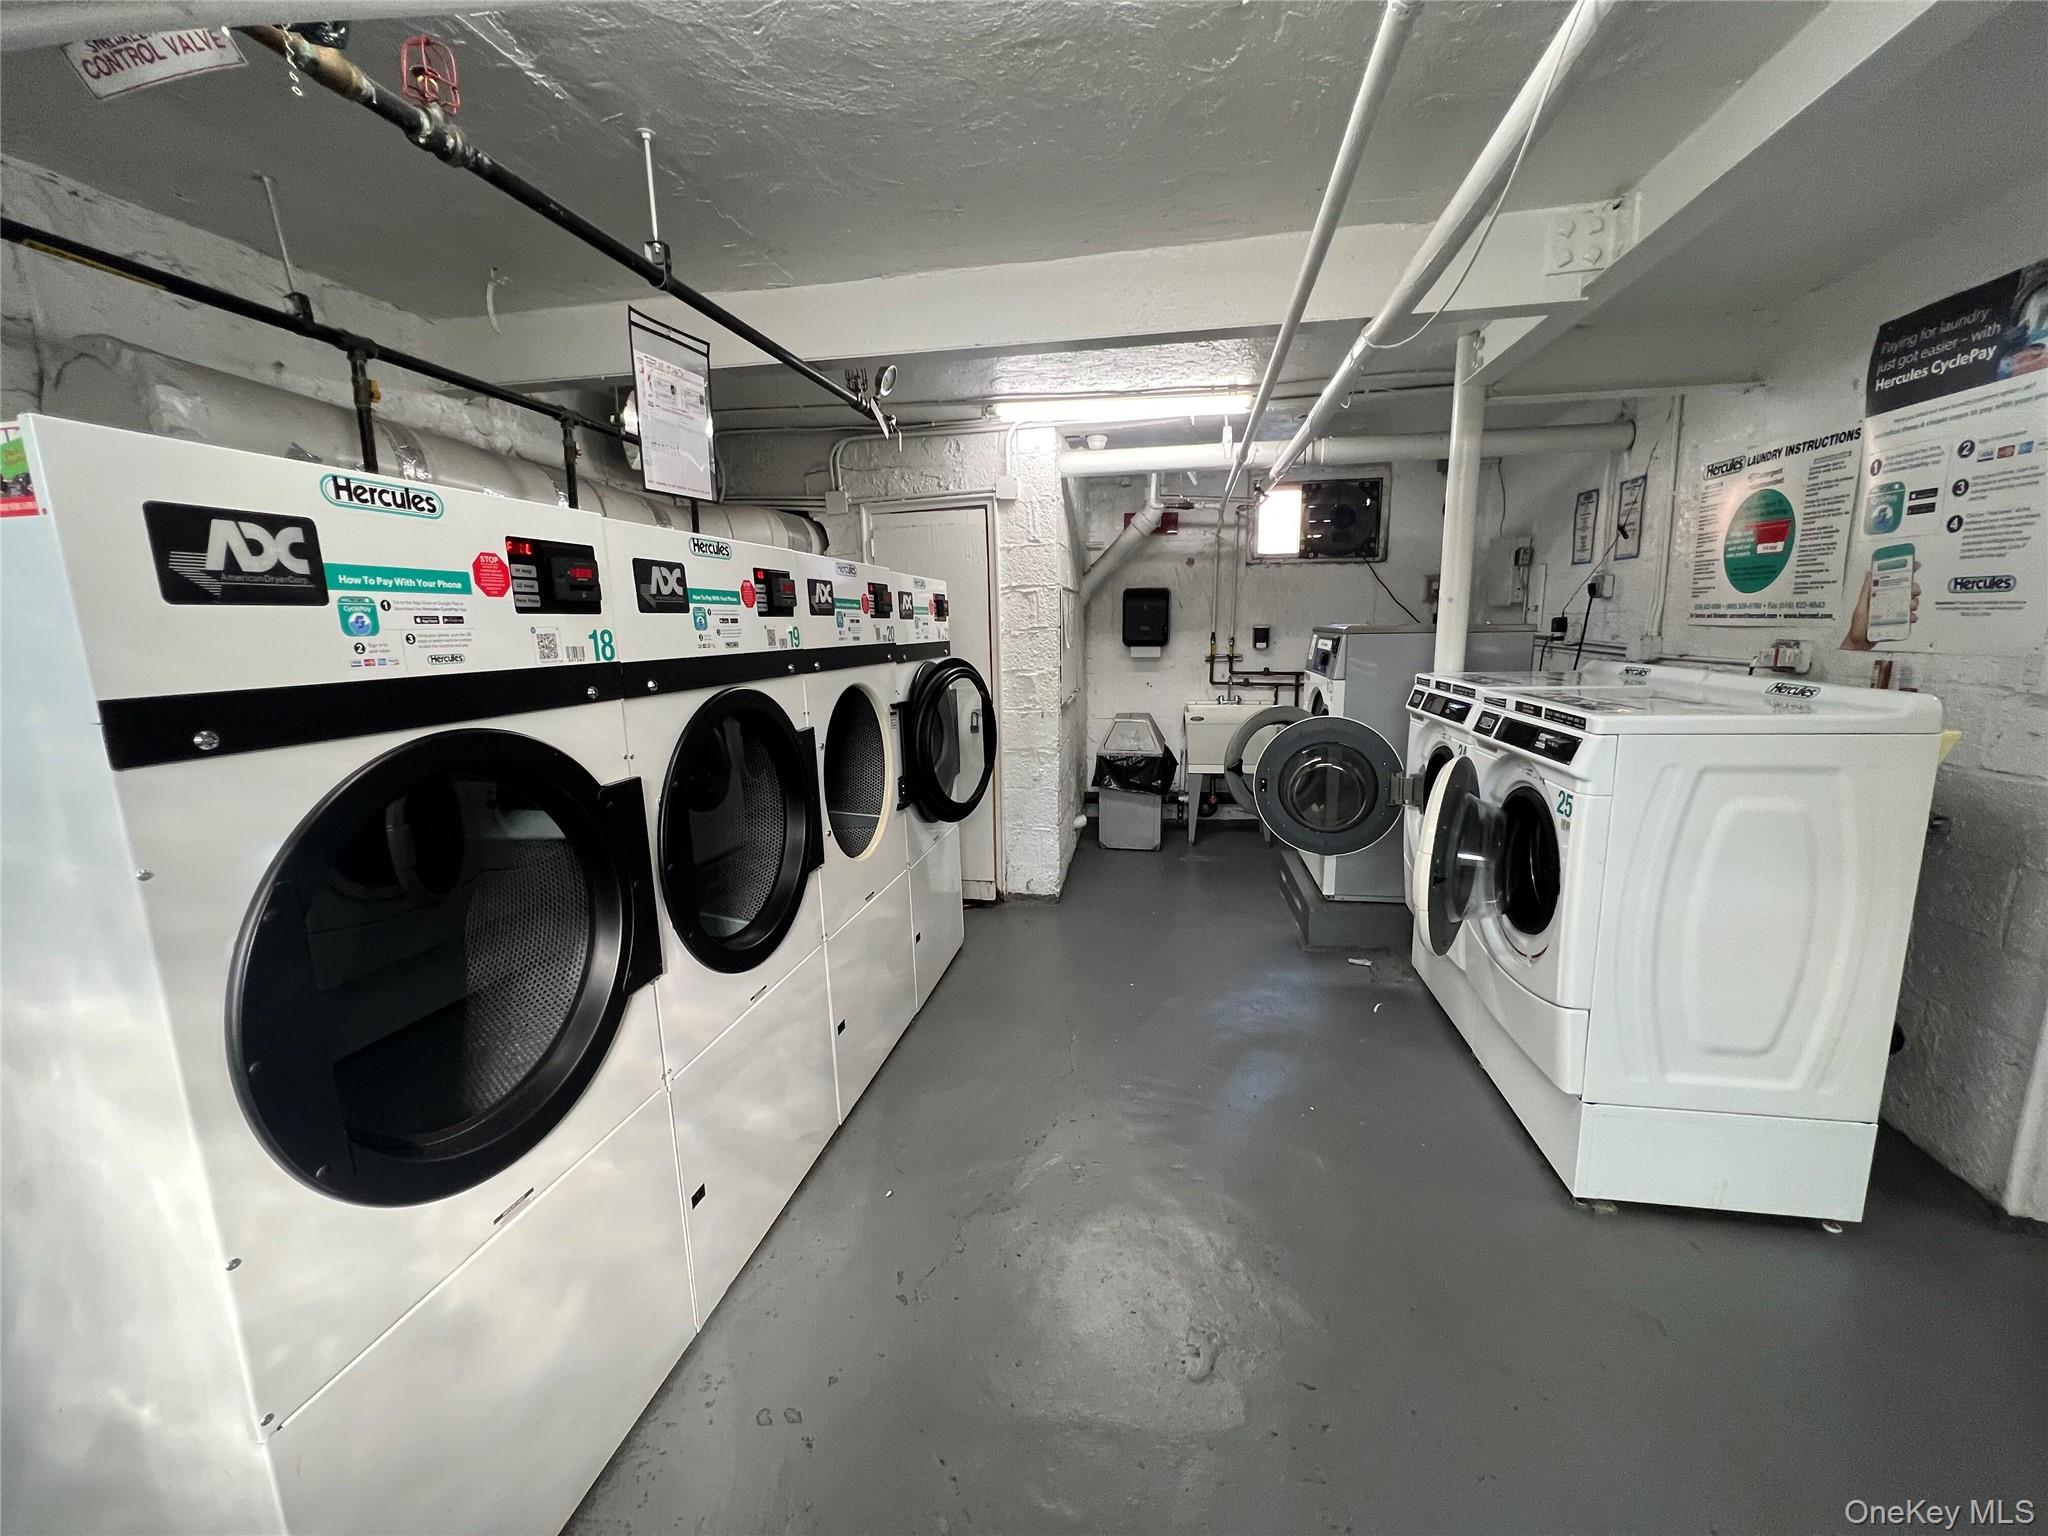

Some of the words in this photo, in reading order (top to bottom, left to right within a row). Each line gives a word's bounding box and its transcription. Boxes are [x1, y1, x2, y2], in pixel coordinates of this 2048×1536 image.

[82, 41, 167, 80] CONTROL
[165, 29, 227, 56] VALVE
[1881, 334, 1918, 355] Paying
[1920, 326, 1937, 339] for
[1939, 307, 1991, 333] laundry
[1877, 358, 1896, 377] just
[1898, 351, 1918, 369] got
[1920, 339, 1958, 359] easier
[1970, 322, 2001, 342] with
[1875, 364, 1929, 392] Hercules
[1931, 344, 1998, 376] CyclePay
[1707, 457, 1744, 478] Hercules
[1747, 446, 1783, 467] LAUNDRY
[1784, 426, 1862, 458] INSTRUCTIONS
[332, 475, 437, 514] Hercules
[206, 518, 311, 574] ADC
[480, 555, 499, 564] STOP
[692, 537, 730, 557] Hercules
[338, 574, 362, 585] How
[364, 575, 376, 585] To
[376, 576, 393, 588] Pay
[395, 577, 416, 588] With
[416, 578, 436, 588] Your
[437, 579, 463, 589] Phone
[650, 566, 684, 596] ADC
[1953, 577, 2011, 591] Hercules
[588, 629, 616, 662] 18
[788, 626, 800, 648] 19
[886, 626, 896, 642] 20
[430, 654, 463, 664] Hercules
[1770, 681, 1819, 699] Hercules
[1557, 790, 1574, 818] 25
